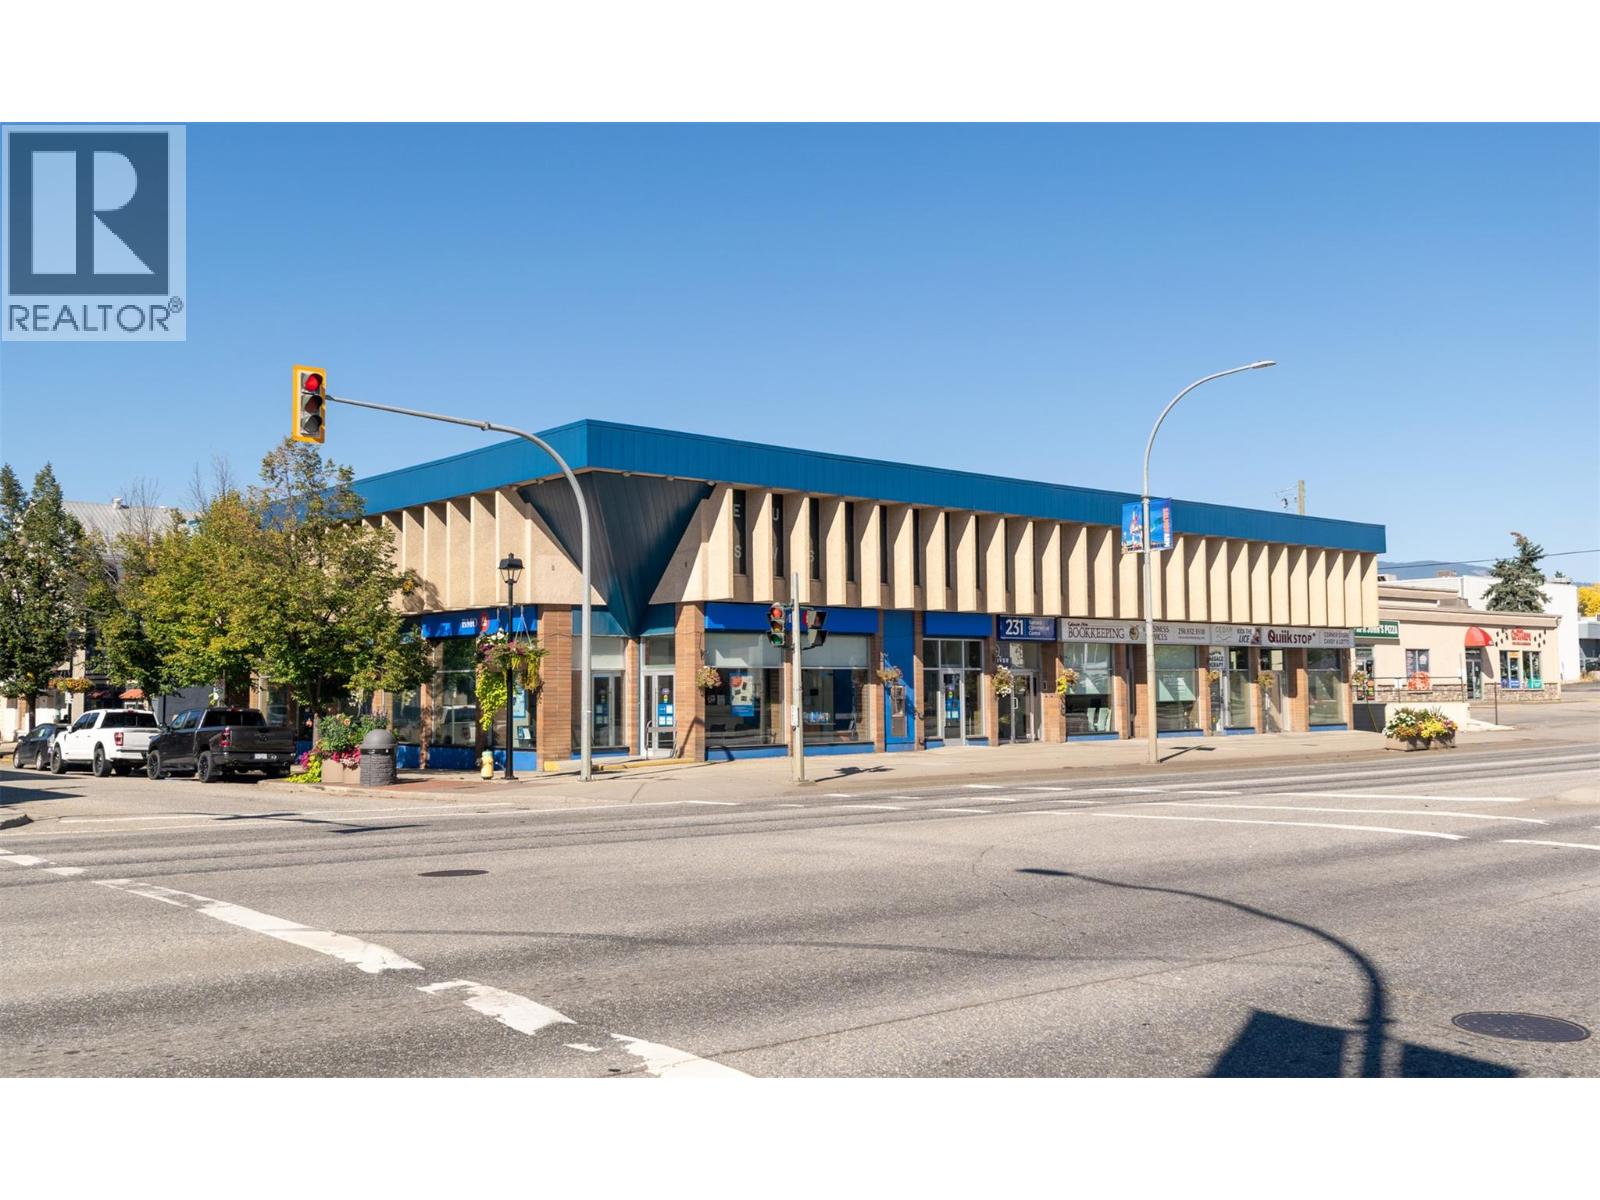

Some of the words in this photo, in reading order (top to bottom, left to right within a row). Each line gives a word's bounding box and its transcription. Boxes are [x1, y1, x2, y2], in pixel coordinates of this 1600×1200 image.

[1005, 619, 1024, 636] 231
[1068, 627, 1125, 639] BOOKKEEPING
[1238, 634, 1250, 643] LICE
[1293, 633, 1312, 644] STOP
